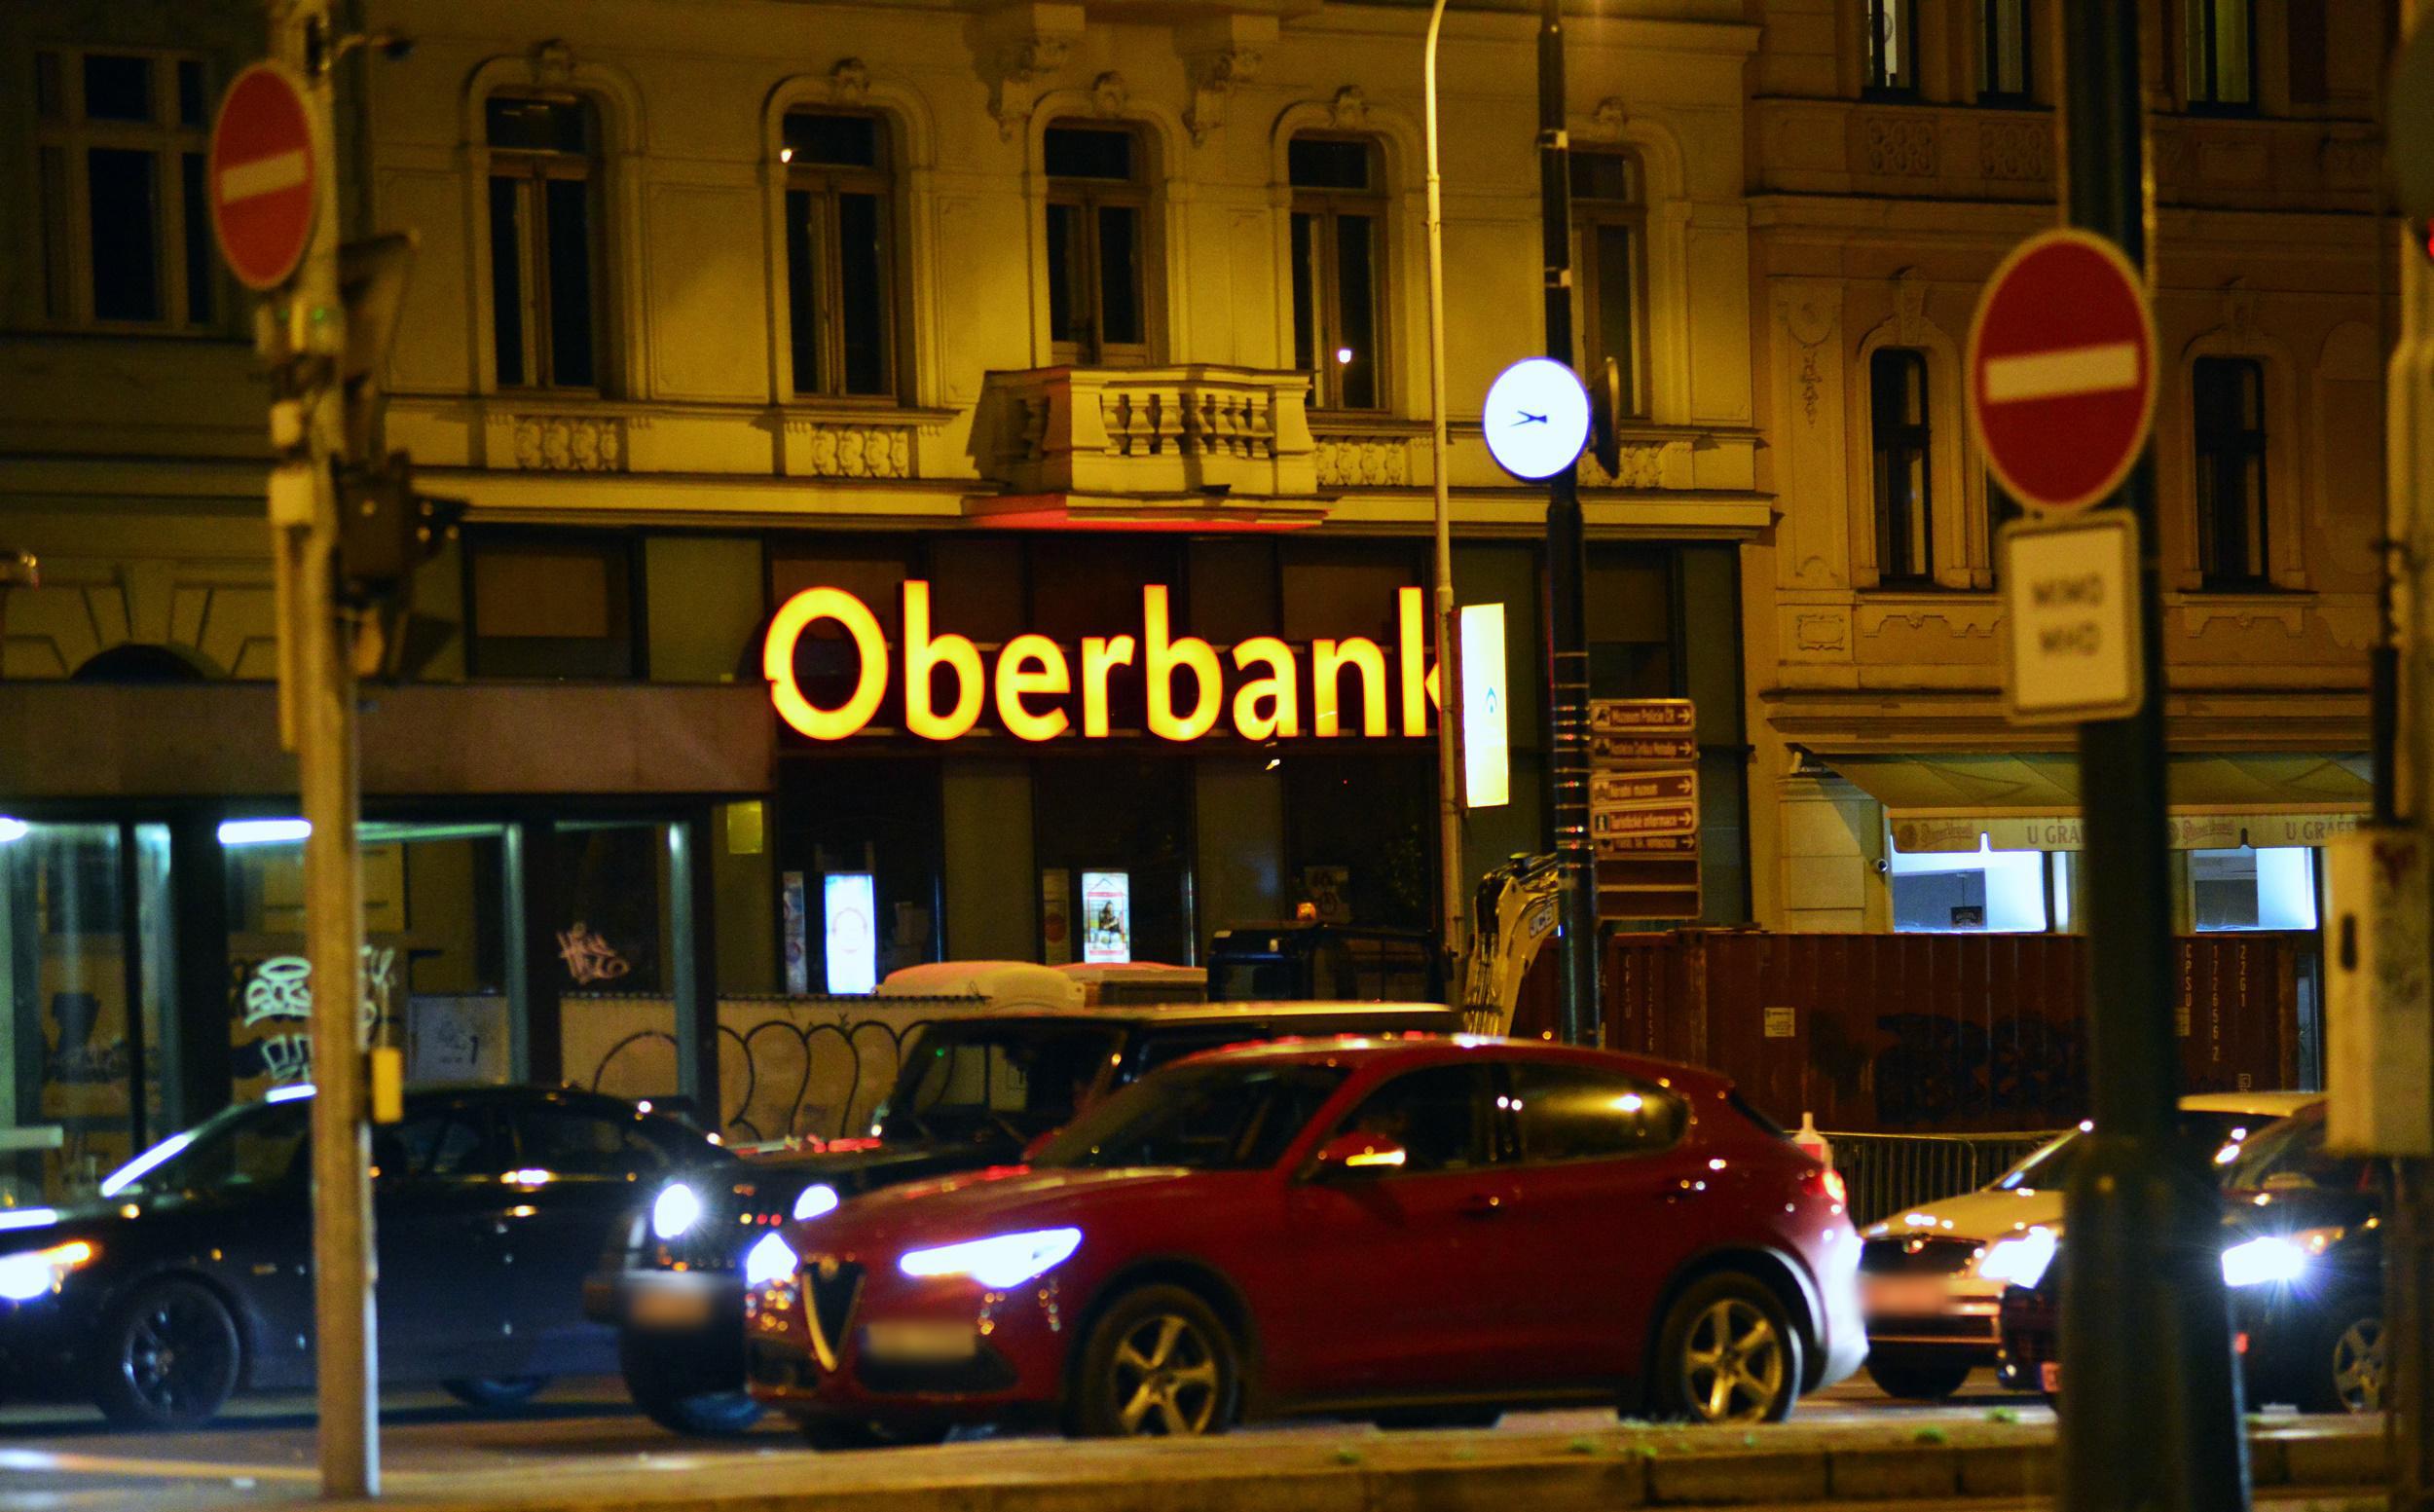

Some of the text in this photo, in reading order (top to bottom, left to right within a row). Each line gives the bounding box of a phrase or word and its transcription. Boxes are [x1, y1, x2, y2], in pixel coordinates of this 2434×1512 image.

[763, 579, 1441, 742] Oberbank
[2026, 826, 2038, 845] U
[1529, 905, 1554, 938] JCB
